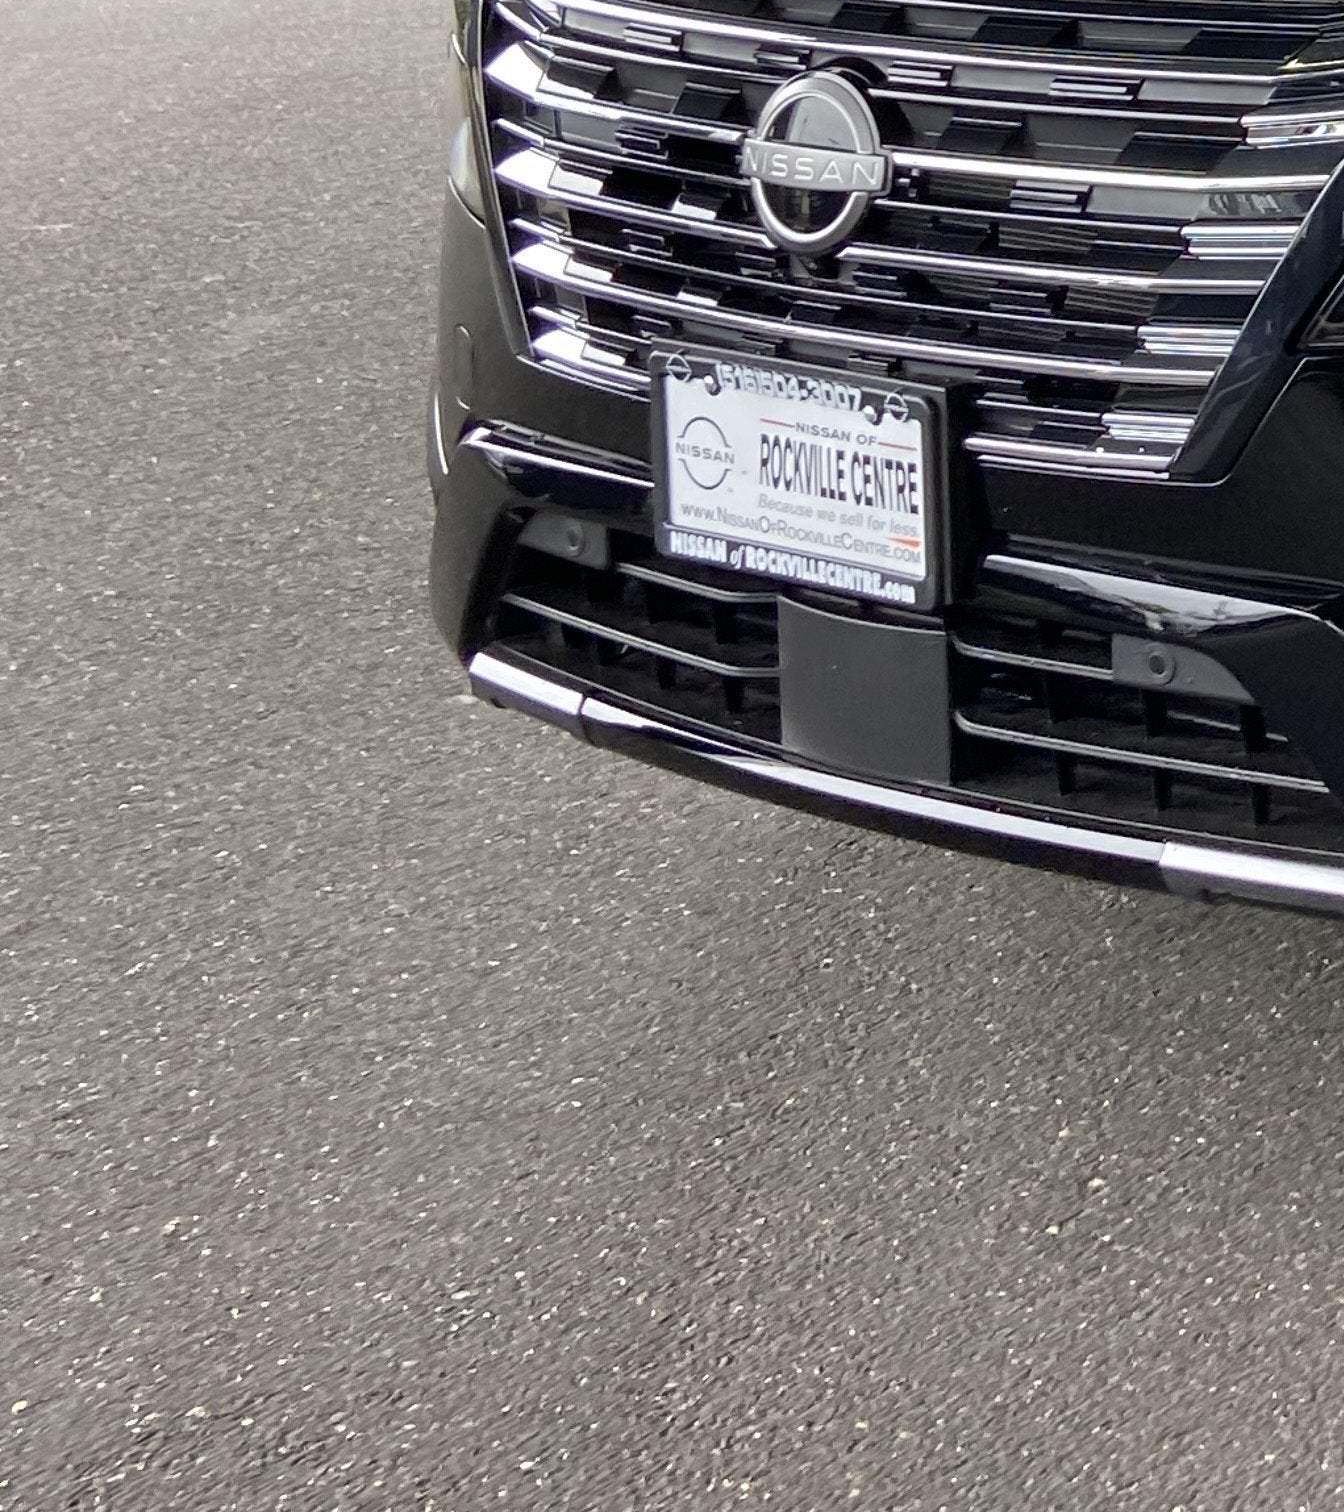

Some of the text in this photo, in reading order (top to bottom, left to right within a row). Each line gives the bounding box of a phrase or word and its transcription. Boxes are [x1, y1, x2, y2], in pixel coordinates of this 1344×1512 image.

[745, 146, 880, 186] NISSAN
[675, 442, 735, 465] NISSAN
[795, 422, 878, 446] NISSAN OF
[759, 433, 919, 515] ROCKVILLE CENTRE
[758, 493, 813, 518] Because
[817, 509, 836, 522] we
[839, 512, 863, 528] sell
[867, 514, 887, 531] for
[670, 530, 727, 563] NISSAN
[729, 545, 745, 570] of
